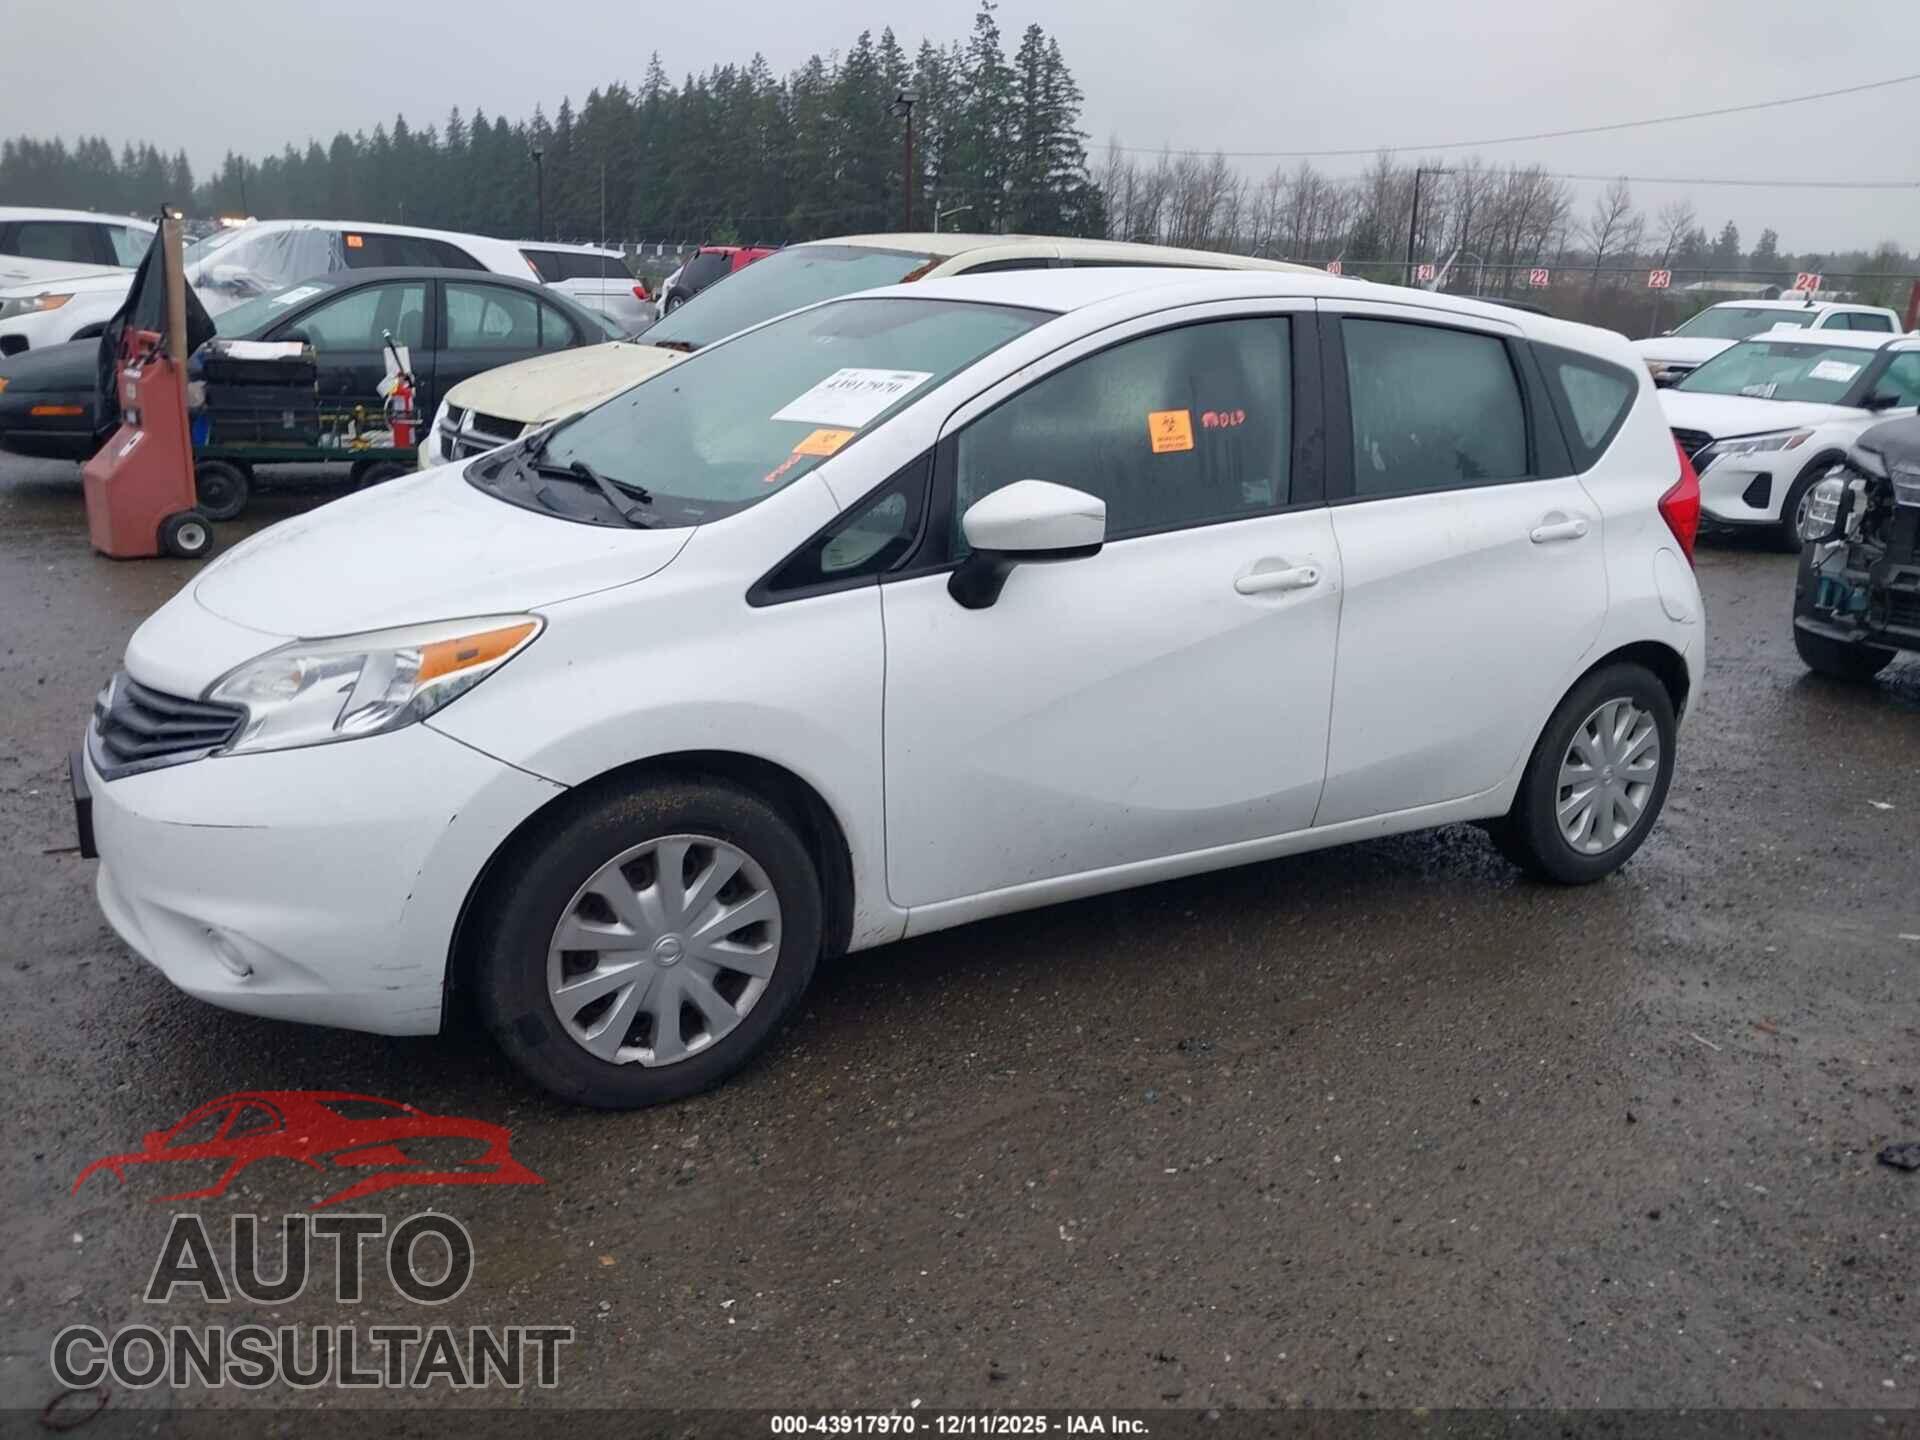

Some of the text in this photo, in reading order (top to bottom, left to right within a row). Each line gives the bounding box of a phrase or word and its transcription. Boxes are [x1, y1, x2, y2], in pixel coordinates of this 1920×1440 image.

[1328, 262, 1340, 275] 20
[1420, 265, 1434, 279] 21
[1530, 270, 1547, 285] 22
[1650, 271, 1669, 287] 23
[1796, 274, 1818, 290] 24
